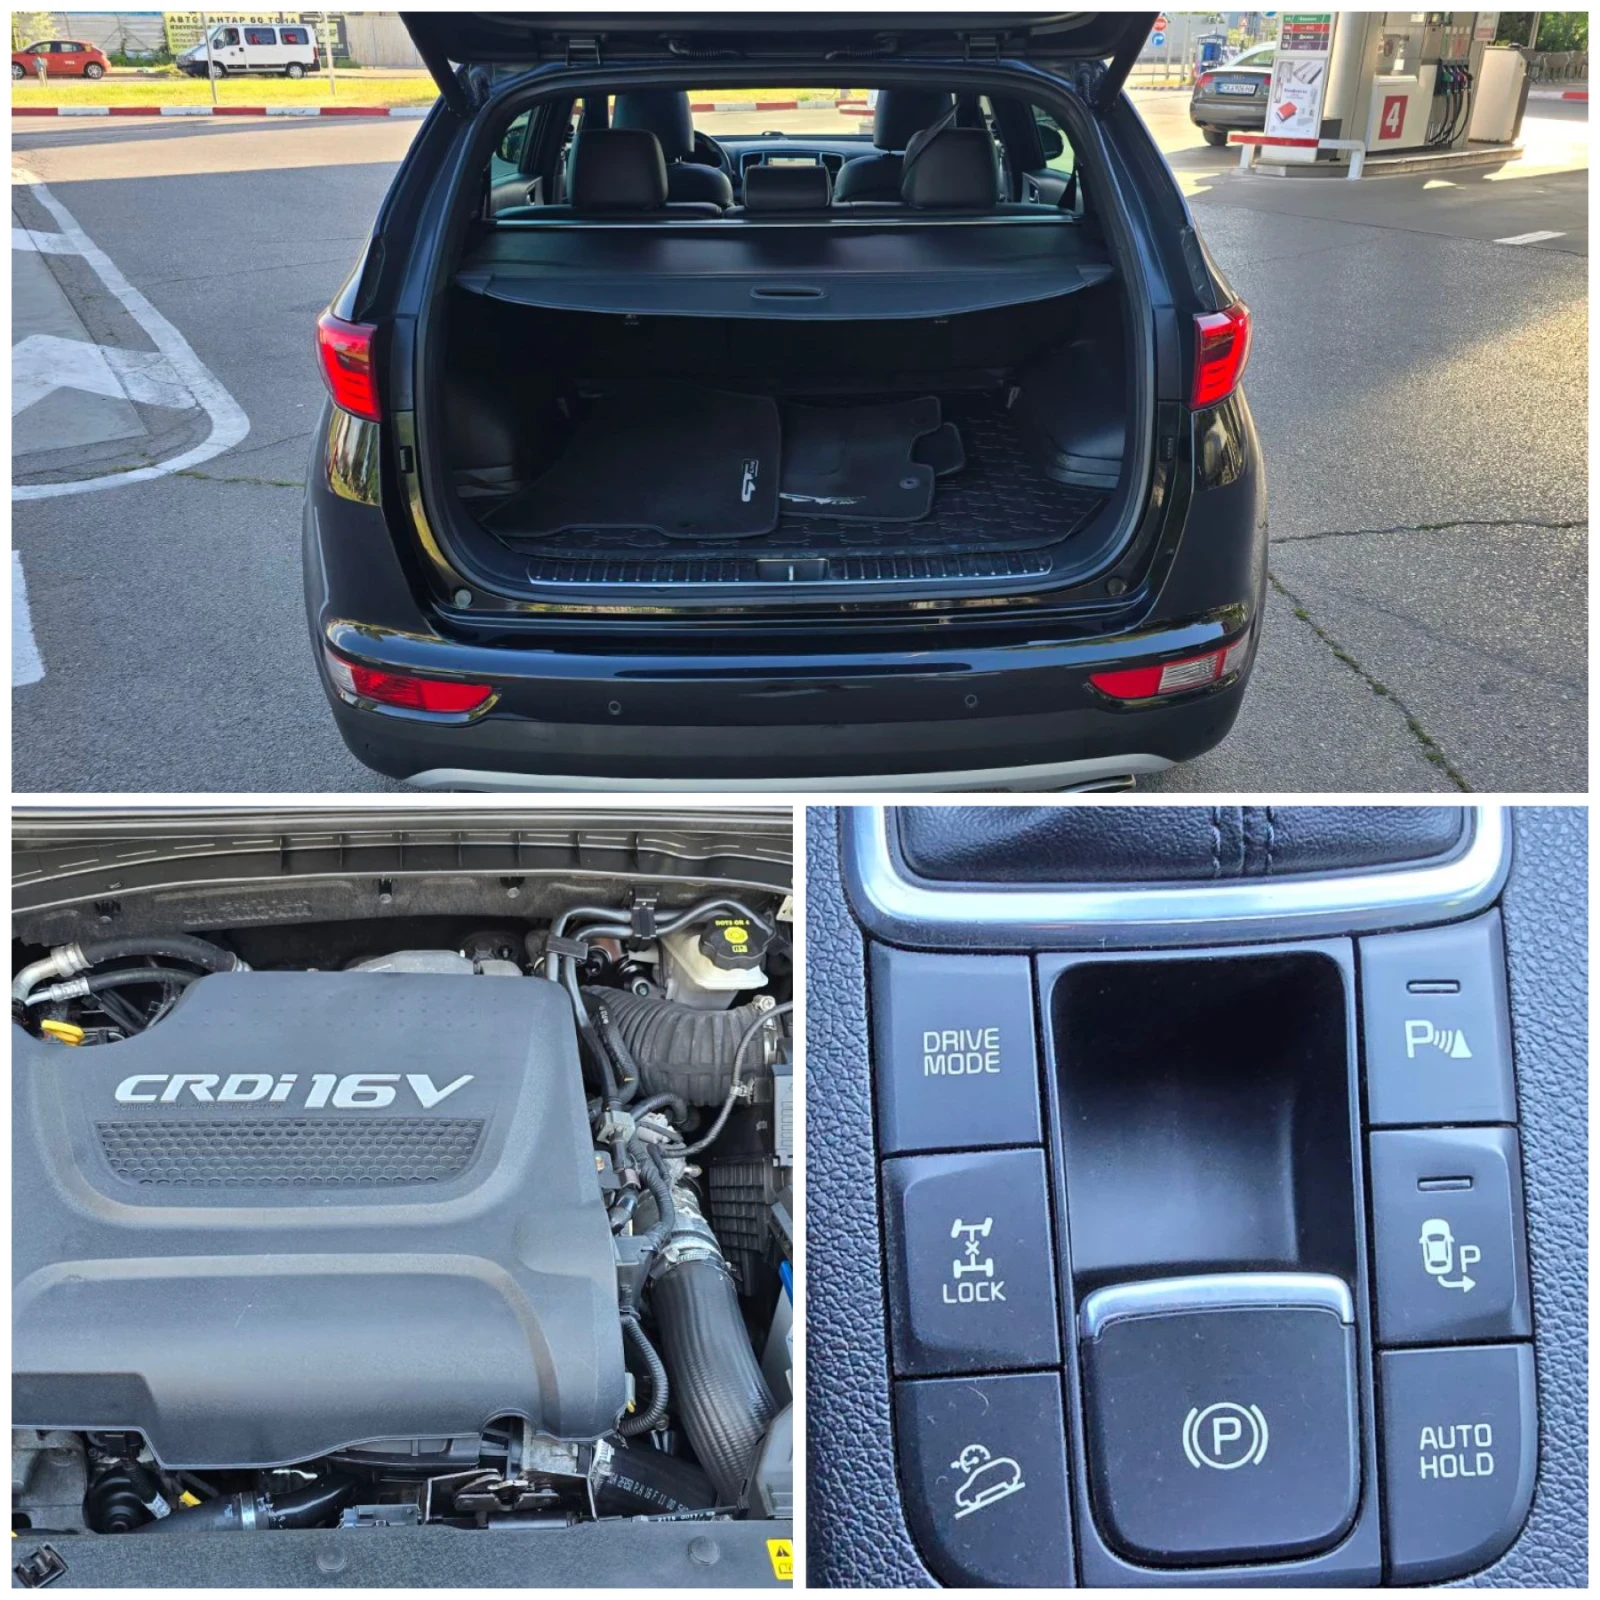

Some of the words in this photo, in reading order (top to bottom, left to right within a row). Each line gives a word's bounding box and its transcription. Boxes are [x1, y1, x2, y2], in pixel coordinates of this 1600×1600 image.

[1385, 102, 1401, 133] 4
[923, 1027, 1000, 1053] DRIVE
[1405, 1019, 1434, 1058] P
[924, 1051, 1001, 1077] MODE
[114, 1074, 298, 1103] CRDi
[304, 1074, 475, 1109] 16V
[1459, 1244, 1481, 1273] P
[942, 1280, 1007, 1303] LOCK
[1212, 1416, 1242, 1456] P
[1419, 1423, 1493, 1450] AUTO
[1420, 1452, 1494, 1479] HOLD
